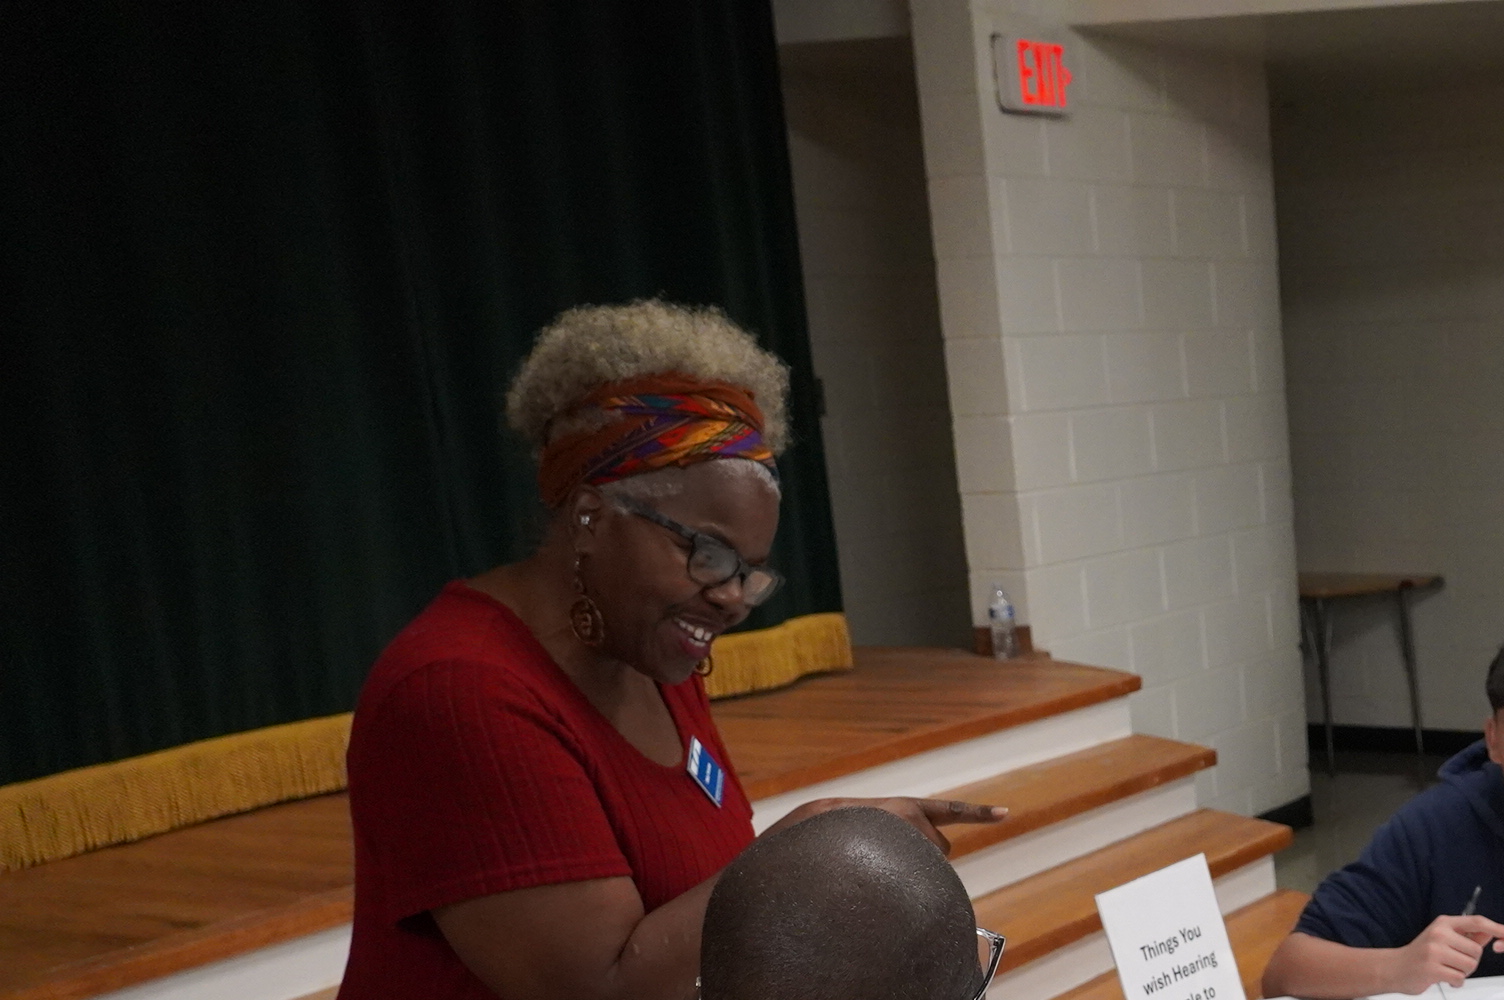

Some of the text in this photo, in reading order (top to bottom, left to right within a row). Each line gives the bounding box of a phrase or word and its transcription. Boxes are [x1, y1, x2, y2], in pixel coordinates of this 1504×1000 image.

[1017, 39, 1067, 107] EXIT
[1140, 926, 1201, 961] Things You
[1143, 951, 1218, 995] wish Hearing
[1203, 986, 1216, 1000] to
